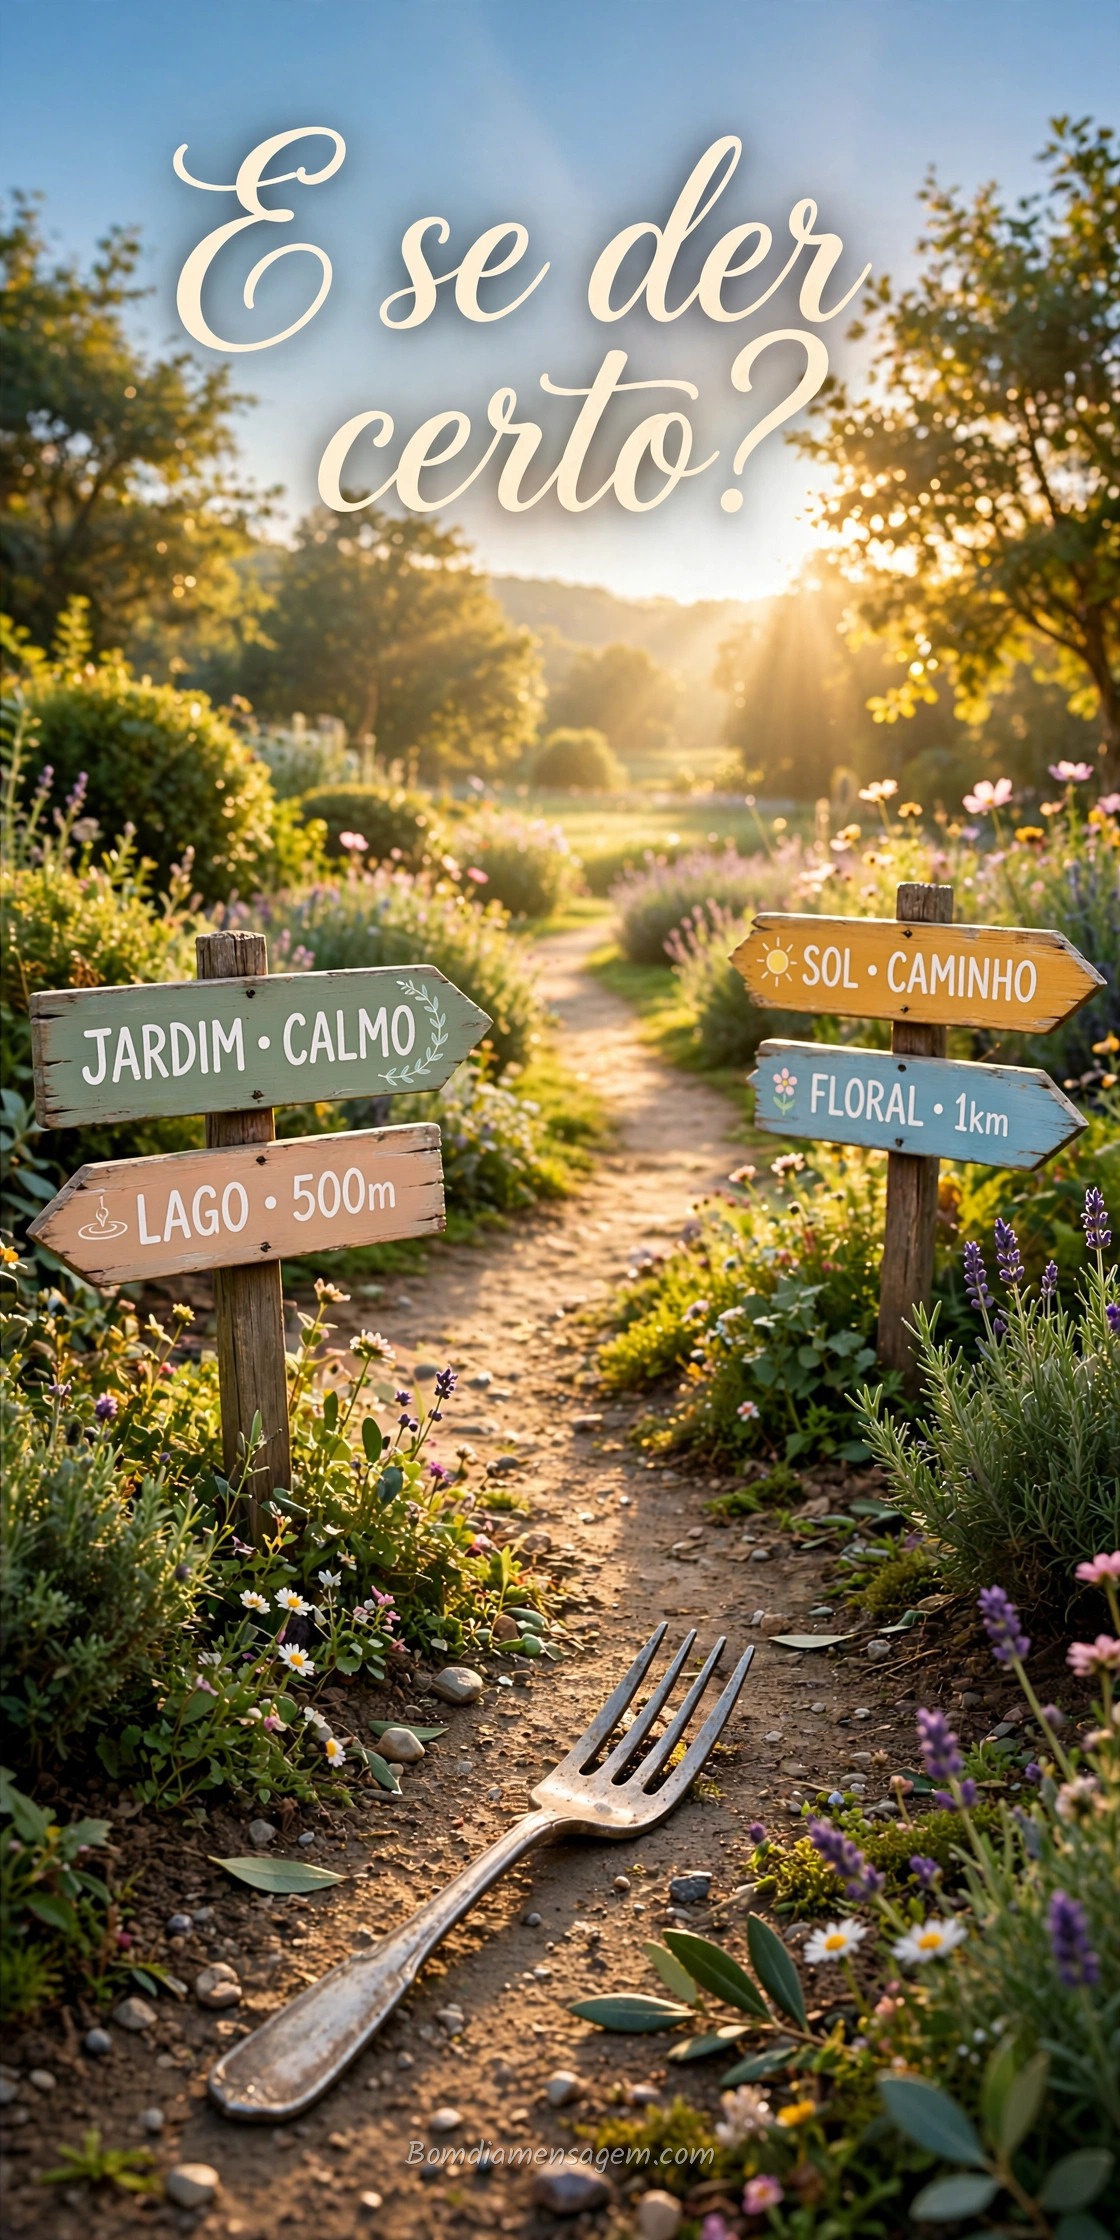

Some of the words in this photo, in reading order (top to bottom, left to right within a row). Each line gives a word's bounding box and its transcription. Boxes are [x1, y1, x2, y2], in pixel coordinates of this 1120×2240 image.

[802, 944, 859, 990] SOL
[886, 951, 1038, 1003] CAMINHO
[81, 1017, 246, 1086] JARDIM
[282, 1004, 416, 1067] CALMO
[810, 1072, 924, 1128] FLORAL
[954, 1093, 1009, 1138] 1km
[136, 1181, 249, 1246] LAGO
[292, 1167, 396, 1223] 500m
